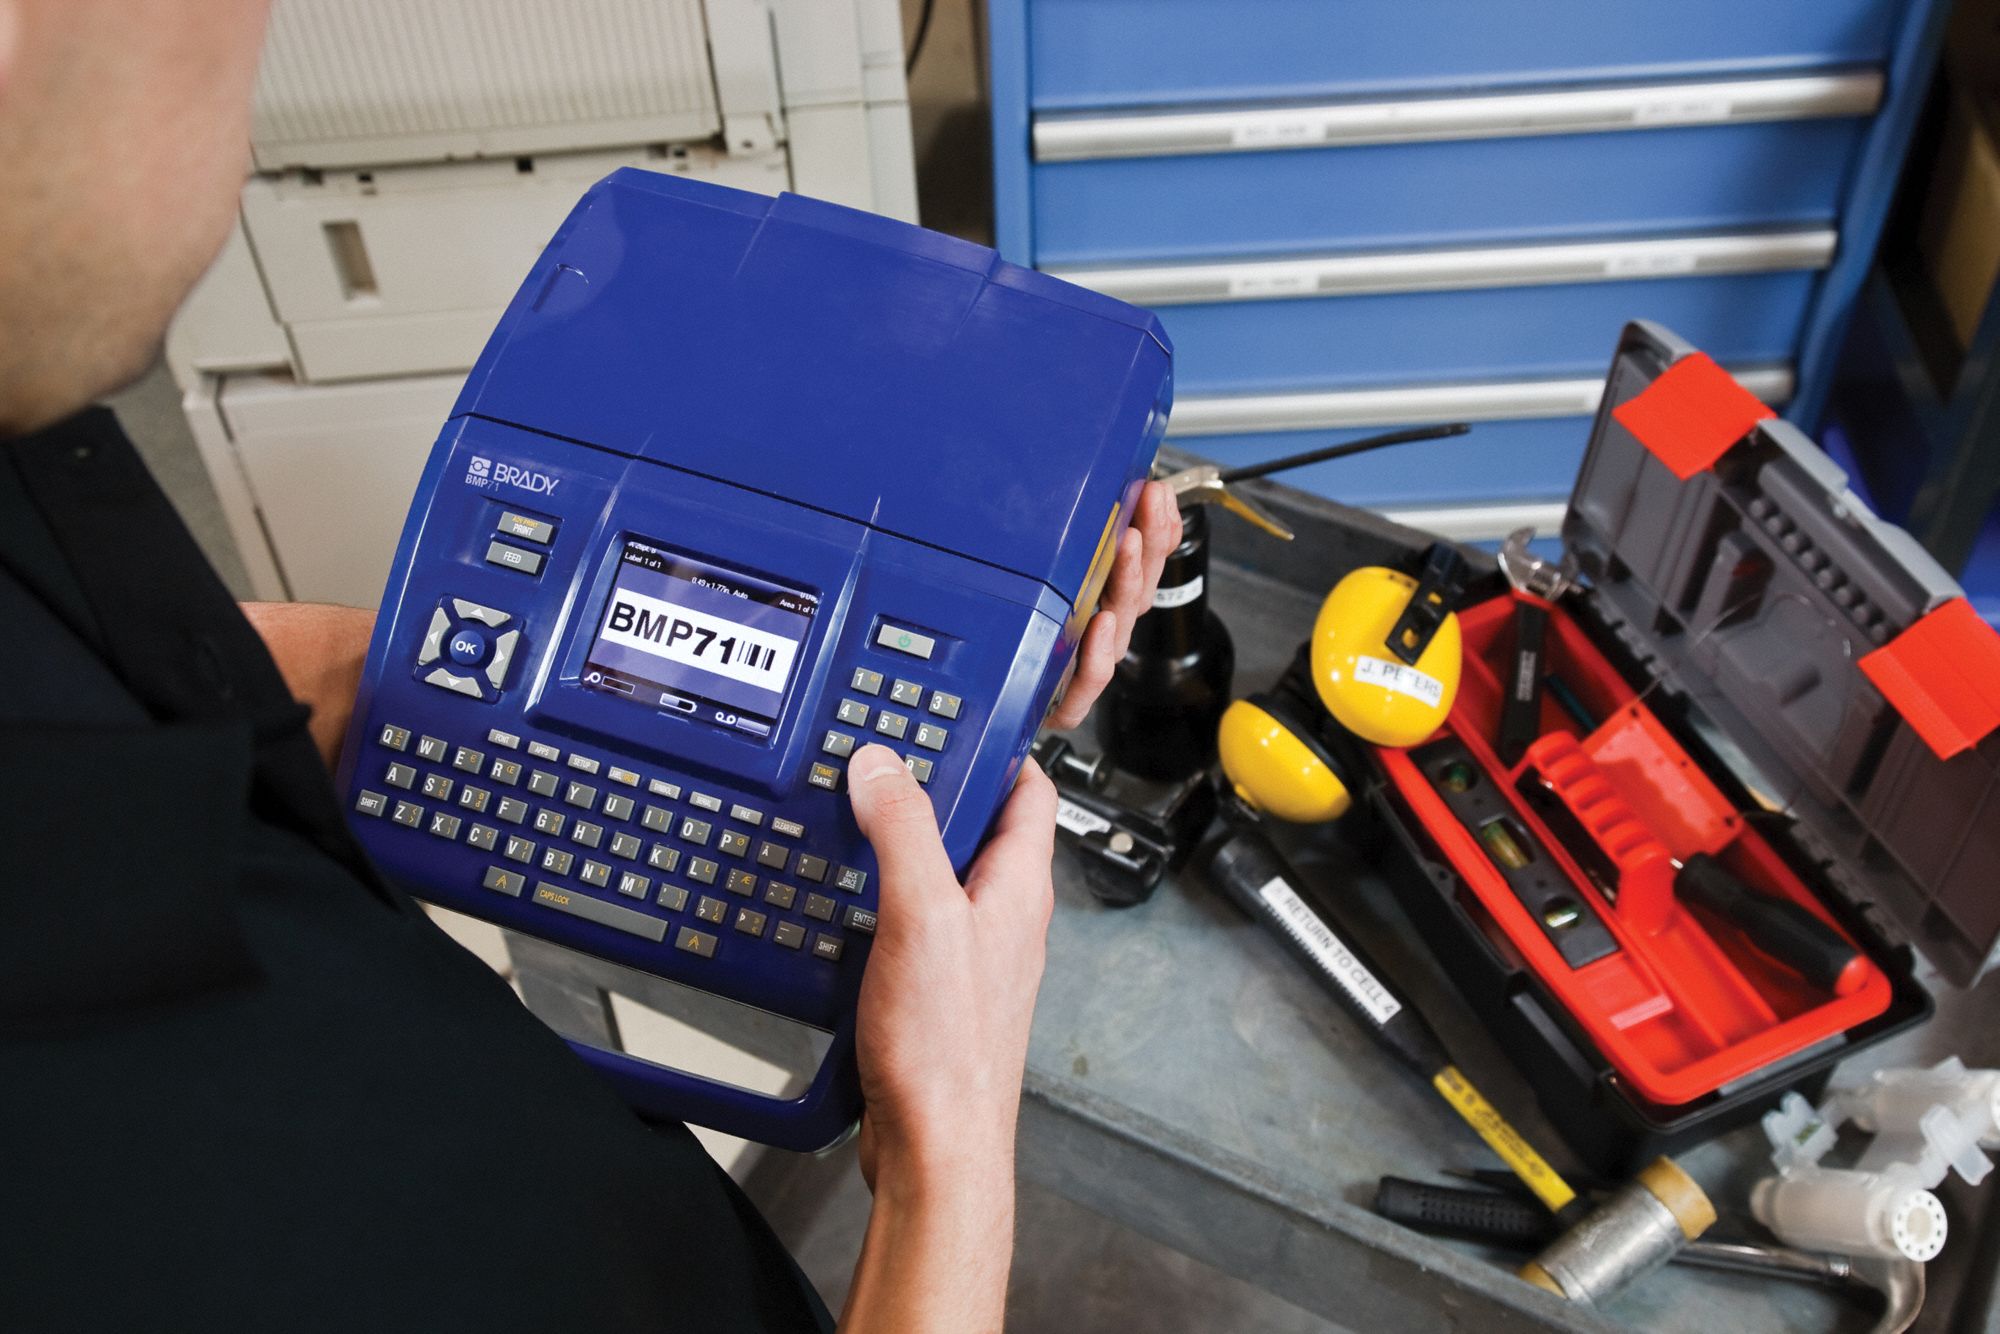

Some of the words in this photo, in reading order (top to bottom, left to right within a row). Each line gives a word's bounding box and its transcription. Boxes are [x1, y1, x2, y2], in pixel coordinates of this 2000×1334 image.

[465, 474, 499, 492] BMP71
[493, 463, 560, 496] BRADY
[512, 523, 535, 536] PRINT
[503, 551, 522, 564] FEED
[624, 551, 643, 563] Label
[733, 589, 749, 600] Auto
[780, 599, 796, 610] Area
[608, 601, 737, 665] BMP71
[455, 641, 477, 656] OK
[857, 672, 865, 687] 1
[893, 684, 904, 699] 2
[840, 703, 851, 718] 4
[932, 696, 943, 710] 3
[880, 715, 890, 730] 5
[382, 728, 393, 744] Q
[494, 733, 511, 745] FONT
[827, 734, 837, 749] 7
[919, 728, 929, 742] 6
[419, 739, 434, 756] W
[455, 750, 466, 765] E
[573, 757, 592, 769] SETUP
[386, 766, 398, 782] A
[491, 762, 503, 777] R
[815, 766, 834, 777] TIME
[424, 777, 436, 793] S
[531, 773, 542, 789] T
[812, 775, 833, 787] DATE
[461, 789, 473, 804] D
[570, 785, 580, 800] Y
[360, 796, 380, 809] SHIFT
[498, 801, 510, 815] F
[606, 797, 618, 812] U
[395, 805, 406, 820] Z
[432, 816, 445, 832] X
[537, 813, 548, 828] G
[469, 827, 481, 843] C
[573, 824, 586, 840] H
[682, 822, 694, 837] O
[508, 840, 519, 855] V
[613, 837, 623, 851] J
[720, 834, 732, 849] P
[544, 852, 556, 867] B
[650, 848, 662, 864] K
[582, 863, 594, 879] N
[688, 860, 698, 876] L
[844, 869, 859, 880] BACK
[620, 876, 636, 893] M
[842, 876, 858, 887] SPACE
[540, 889, 556, 901] CAPS
[555, 894, 571, 905] LOCK
[853, 911, 877, 926] ENTER
[818, 941, 838, 954] SHIFT
[1283, 896, 1336, 950] RETURN
[1333, 946, 1353, 970] TO
[1351, 968, 1384, 1006] CELL
[1383, 1001, 1396, 1014] 4
